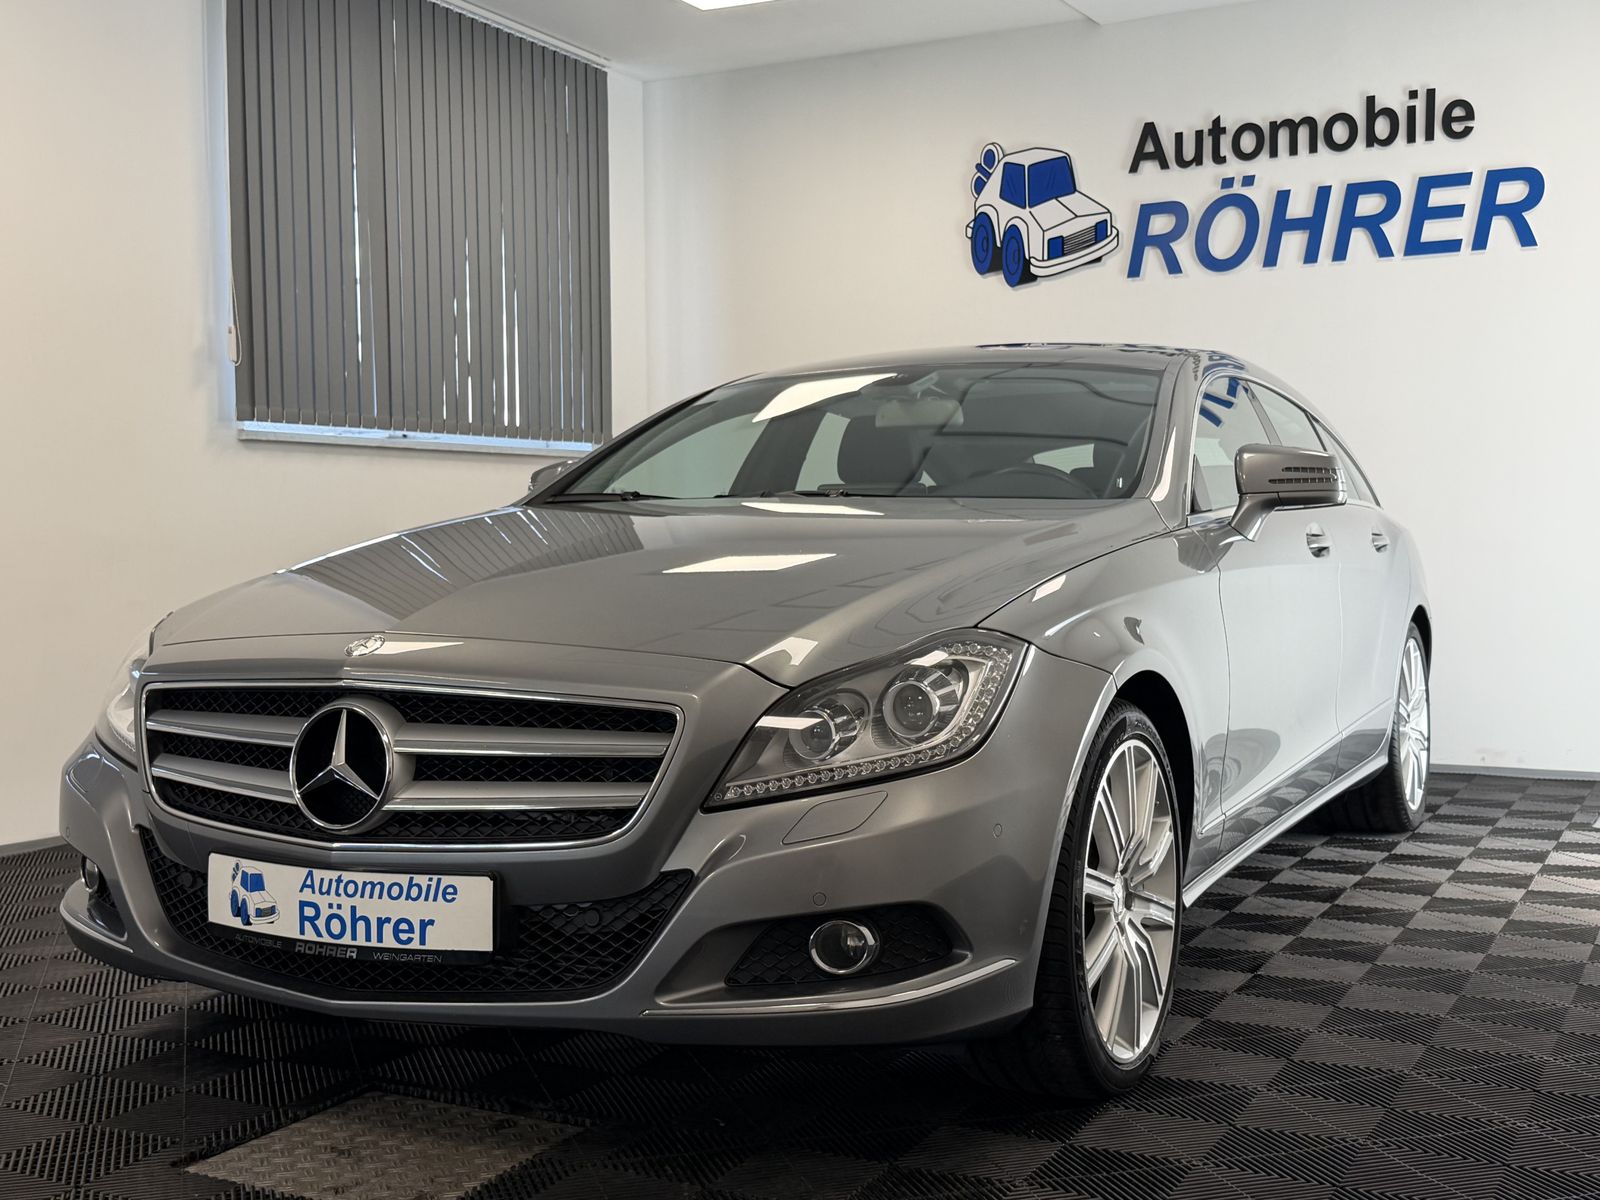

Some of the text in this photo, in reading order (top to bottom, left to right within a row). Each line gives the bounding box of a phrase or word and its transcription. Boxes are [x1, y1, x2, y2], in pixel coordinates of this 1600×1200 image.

[1129, 87, 1476, 174] Automobile
[1127, 166, 1546, 279] RÖHRER
[299, 869, 458, 903] Automobile
[298, 899, 436, 946] Röhrer
[372, 951, 443, 964] WEINGARTEN
